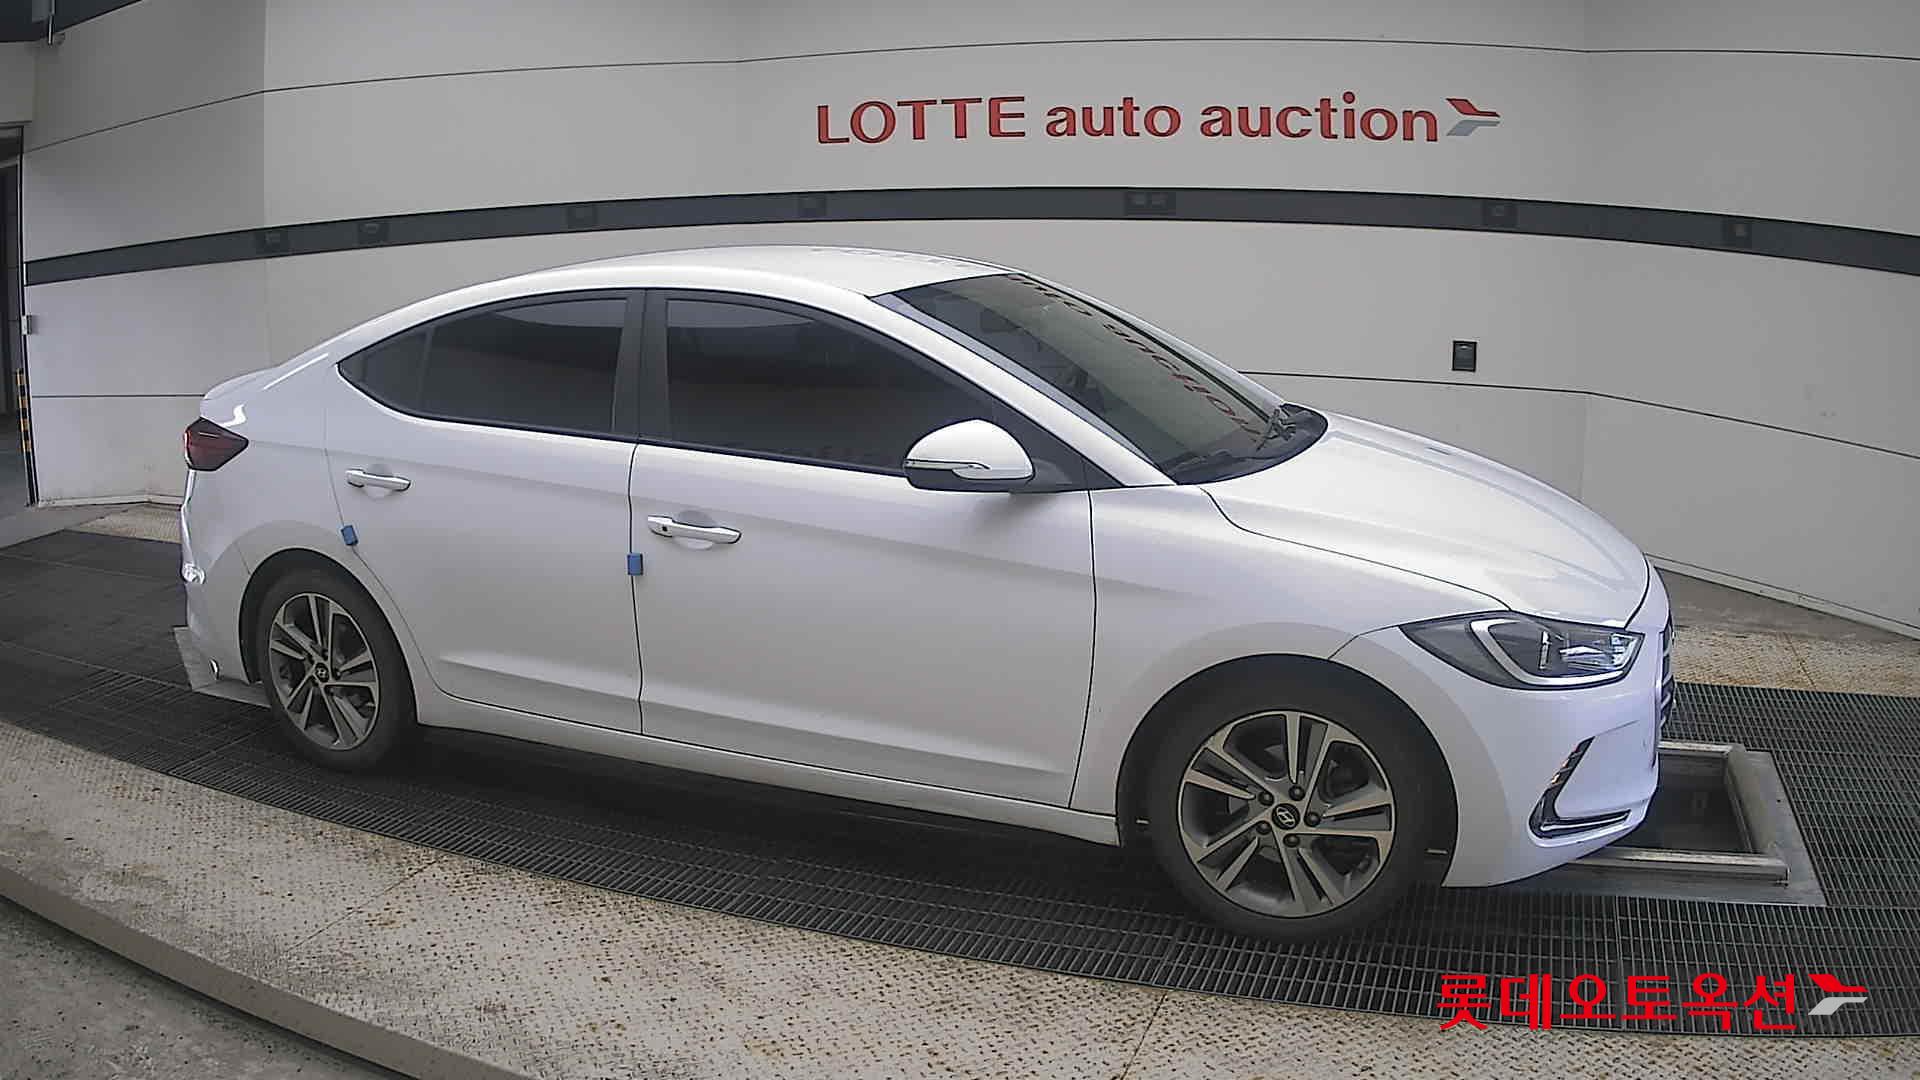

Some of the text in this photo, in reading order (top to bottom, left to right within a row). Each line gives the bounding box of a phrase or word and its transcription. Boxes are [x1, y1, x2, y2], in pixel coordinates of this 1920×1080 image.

[816, 91, 1440, 145] LOTTE auto auction
